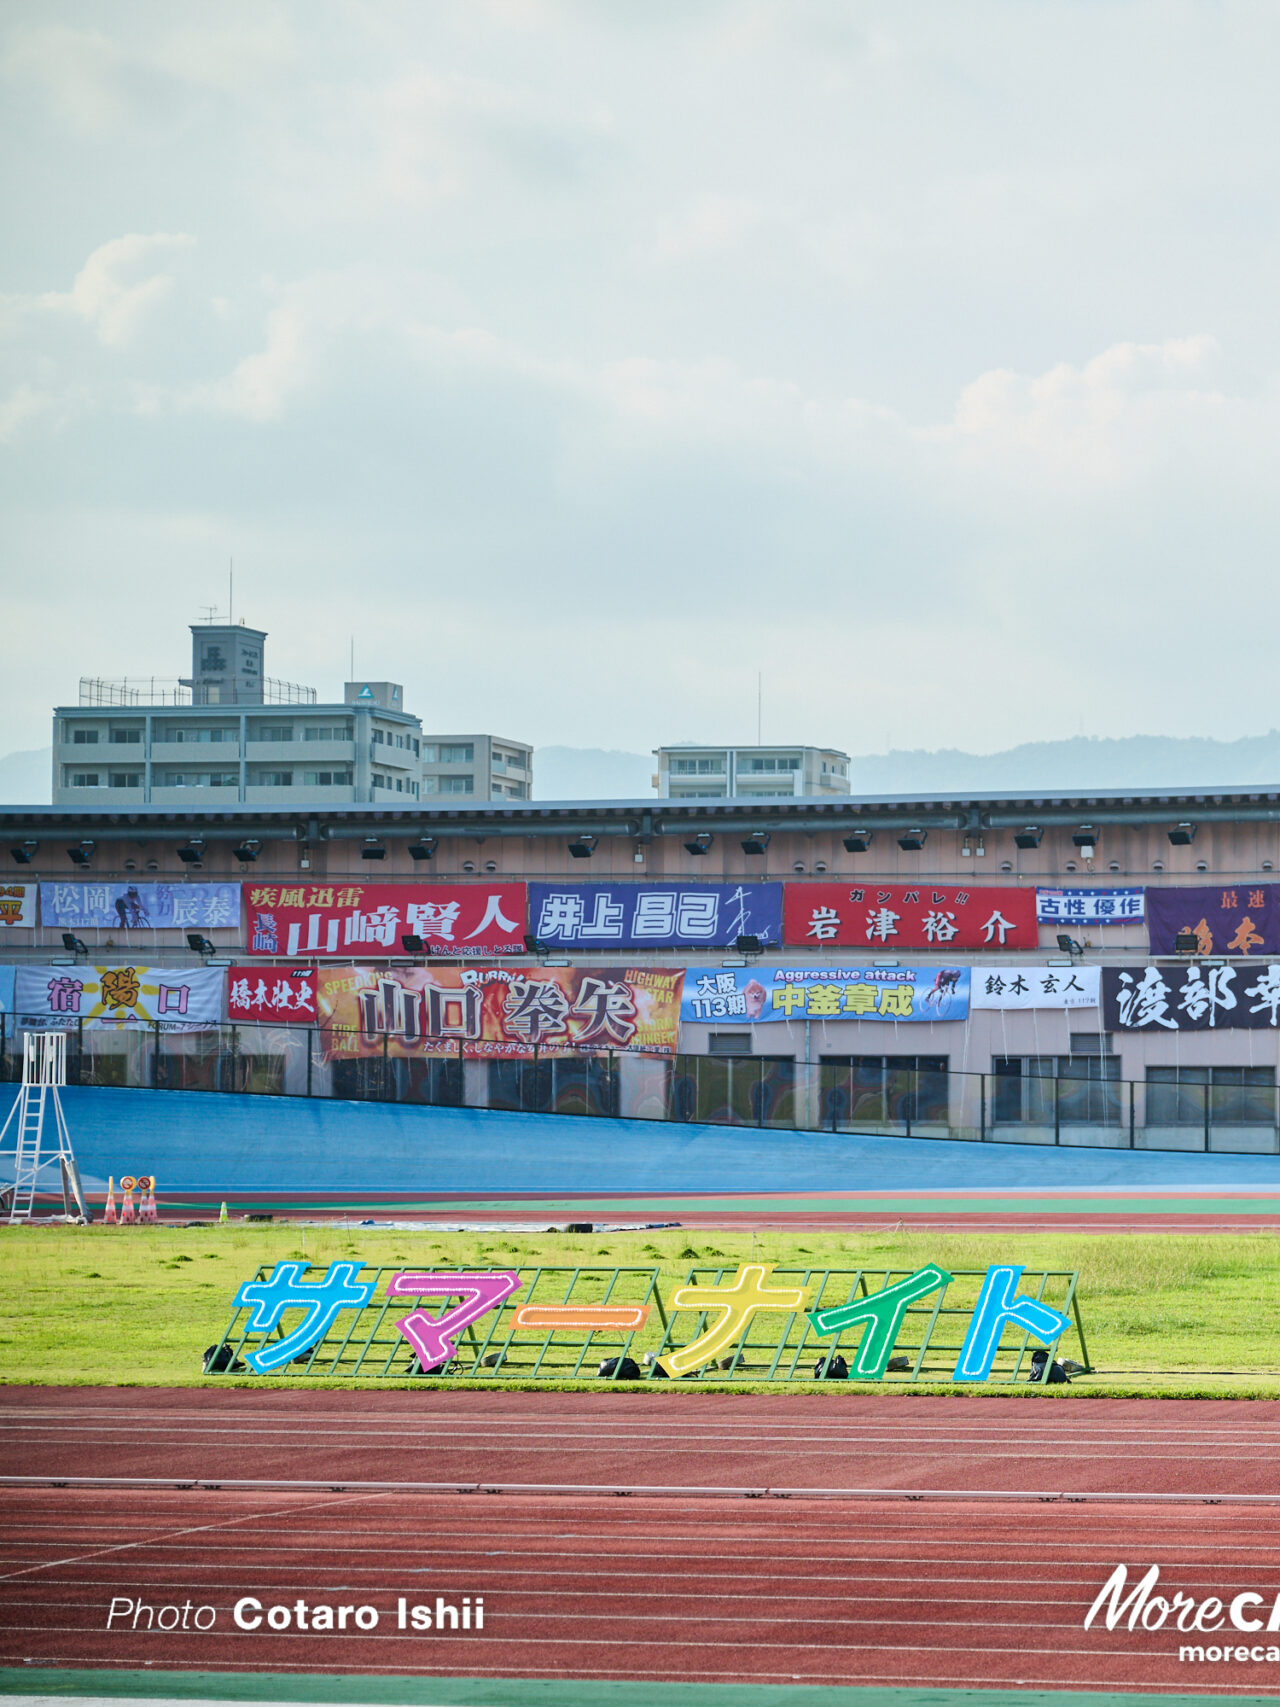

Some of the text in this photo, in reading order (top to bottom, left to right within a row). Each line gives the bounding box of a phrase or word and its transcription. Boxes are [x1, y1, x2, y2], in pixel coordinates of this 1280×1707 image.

[51, 885, 233, 925] 松岡 辰泰
[250, 887, 364, 908] 疾風迅雷
[1039, 898, 1141, 915] 古性優作
[536, 892, 720, 940] 井上昌己
[806, 905, 1017, 944] 岩津裕介
[624, 969, 678, 989] HIGHWAY
[697, 973, 737, 996] 大阪
[773, 968, 917, 982] Aggressive attack
[985, 974, 1085, 996] 鈴木玄人
[47, 977, 83, 1012] 宿
[230, 978, 314, 1012] 橋本壮史
[692, 994, 748, 1018] 113期
[772, 983, 915, 1016] 中釜章成
[359, 977, 637, 1043] 山口拳矢
[331, 1023, 357, 1038] FIRE
[331, 1037, 360, 1052] BALL
[231, 1261, 1072, 1382] サマーナイト
